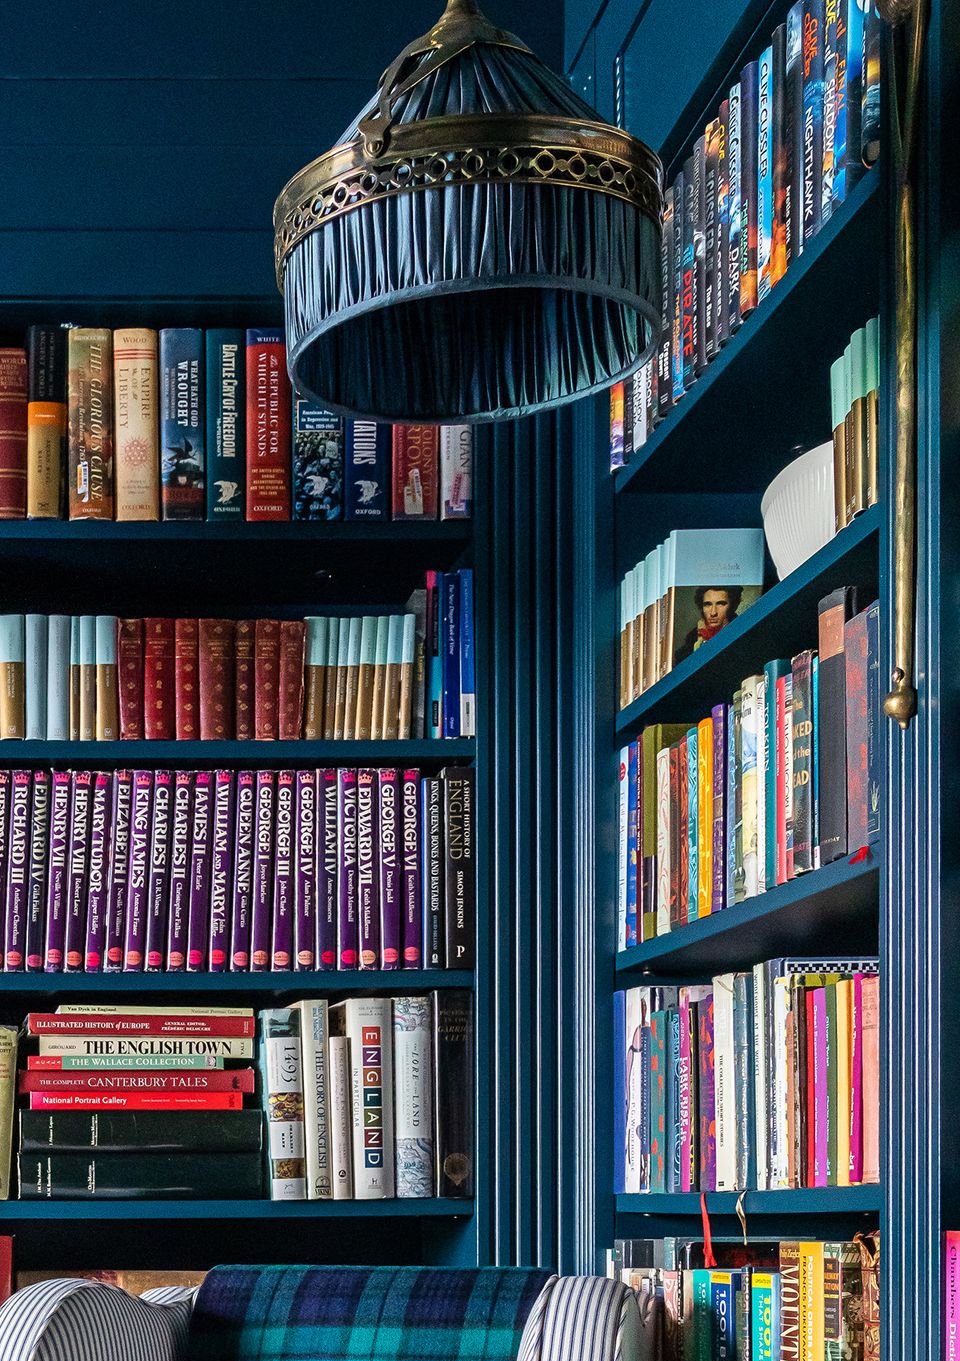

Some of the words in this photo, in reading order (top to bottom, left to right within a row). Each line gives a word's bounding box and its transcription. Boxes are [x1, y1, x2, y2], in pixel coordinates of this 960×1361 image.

[760, 62, 770, 107] CLIVE
[824, 79, 837, 153] SHADOW
[759, 108, 770, 181] CUSSLER
[804, 105, 816, 222] NIGHTHAWK
[682, 270, 693, 357] PIRATE
[91, 344, 102, 372] THE
[662, 340, 670, 381] Crescent
[90, 377, 103, 451] GLORIOUS
[120, 368, 129, 429] LIBERTY
[141, 368, 151, 421] EMPIRE
[178, 360, 188, 427] WROUGHT
[90, 455, 103, 502] CAUSE
[253, 504, 283, 512] OXFORD
[355, 508, 381, 516] OXFORD
[12, 786, 29, 864] RICHARD
[32, 785, 47, 862] EDWARD
[53, 785, 68, 845] HENRY
[73, 790, 88, 847] HENRY
[93, 789, 105, 835] MARY
[135, 789, 150, 829] KING
[174, 787, 189, 863] CHARLES
[215, 784, 229, 852] WILLIAM
[239, 789, 253, 844] QUEEN
[279, 788, 291, 856] GEORGE
[301, 787, 314, 857] GEORGE
[325, 785, 336, 854] WILLIAM
[344, 787, 357, 867] VICTORIA
[359, 787, 372, 858] EDWARD
[382, 784, 395, 855] GEORGE
[404, 782, 416, 852] GEORGE
[449, 780, 462, 860] ENGLAND
[11, 868, 24, 884] III
[51, 847, 64, 867] VII
[72, 848, 85, 875] VIII
[90, 836, 104, 893] TUDOR
[131, 832, 147, 888] JAMES
[237, 847, 251, 893] ANNE
[278, 860, 289, 876] III
[213, 870, 226, 918] MARY
[456, 898, 464, 929] JENKINS
[36, 1020, 83, 1031] ILLUSTRATED
[84, 1021, 114, 1031] HISTORY
[122, 1022, 150, 1032] EUROPE
[83, 1040, 114, 1055] THE
[120, 1040, 184, 1055] ENGLISH
[186, 1040, 233, 1056] TOWN
[70, 1058, 90, 1066] THE
[91, 1057, 132, 1067] WALLACE
[133, 1057, 195, 1067] COLLECTION
[87, 1076, 168, 1088] CANTERBURY
[170, 1076, 208, 1088] TALES
[42, 1096, 73, 1105] National
[74, 1096, 100, 1105] Portrait
[102, 1096, 127, 1107] Gallery
[364, 1030, 382, 1166] ENGLAND
[807, 1255, 816, 1305] POLITICAL
[949, 1245, 957, 1319] Chambers
[807, 1311, 815, 1343] ORDER
